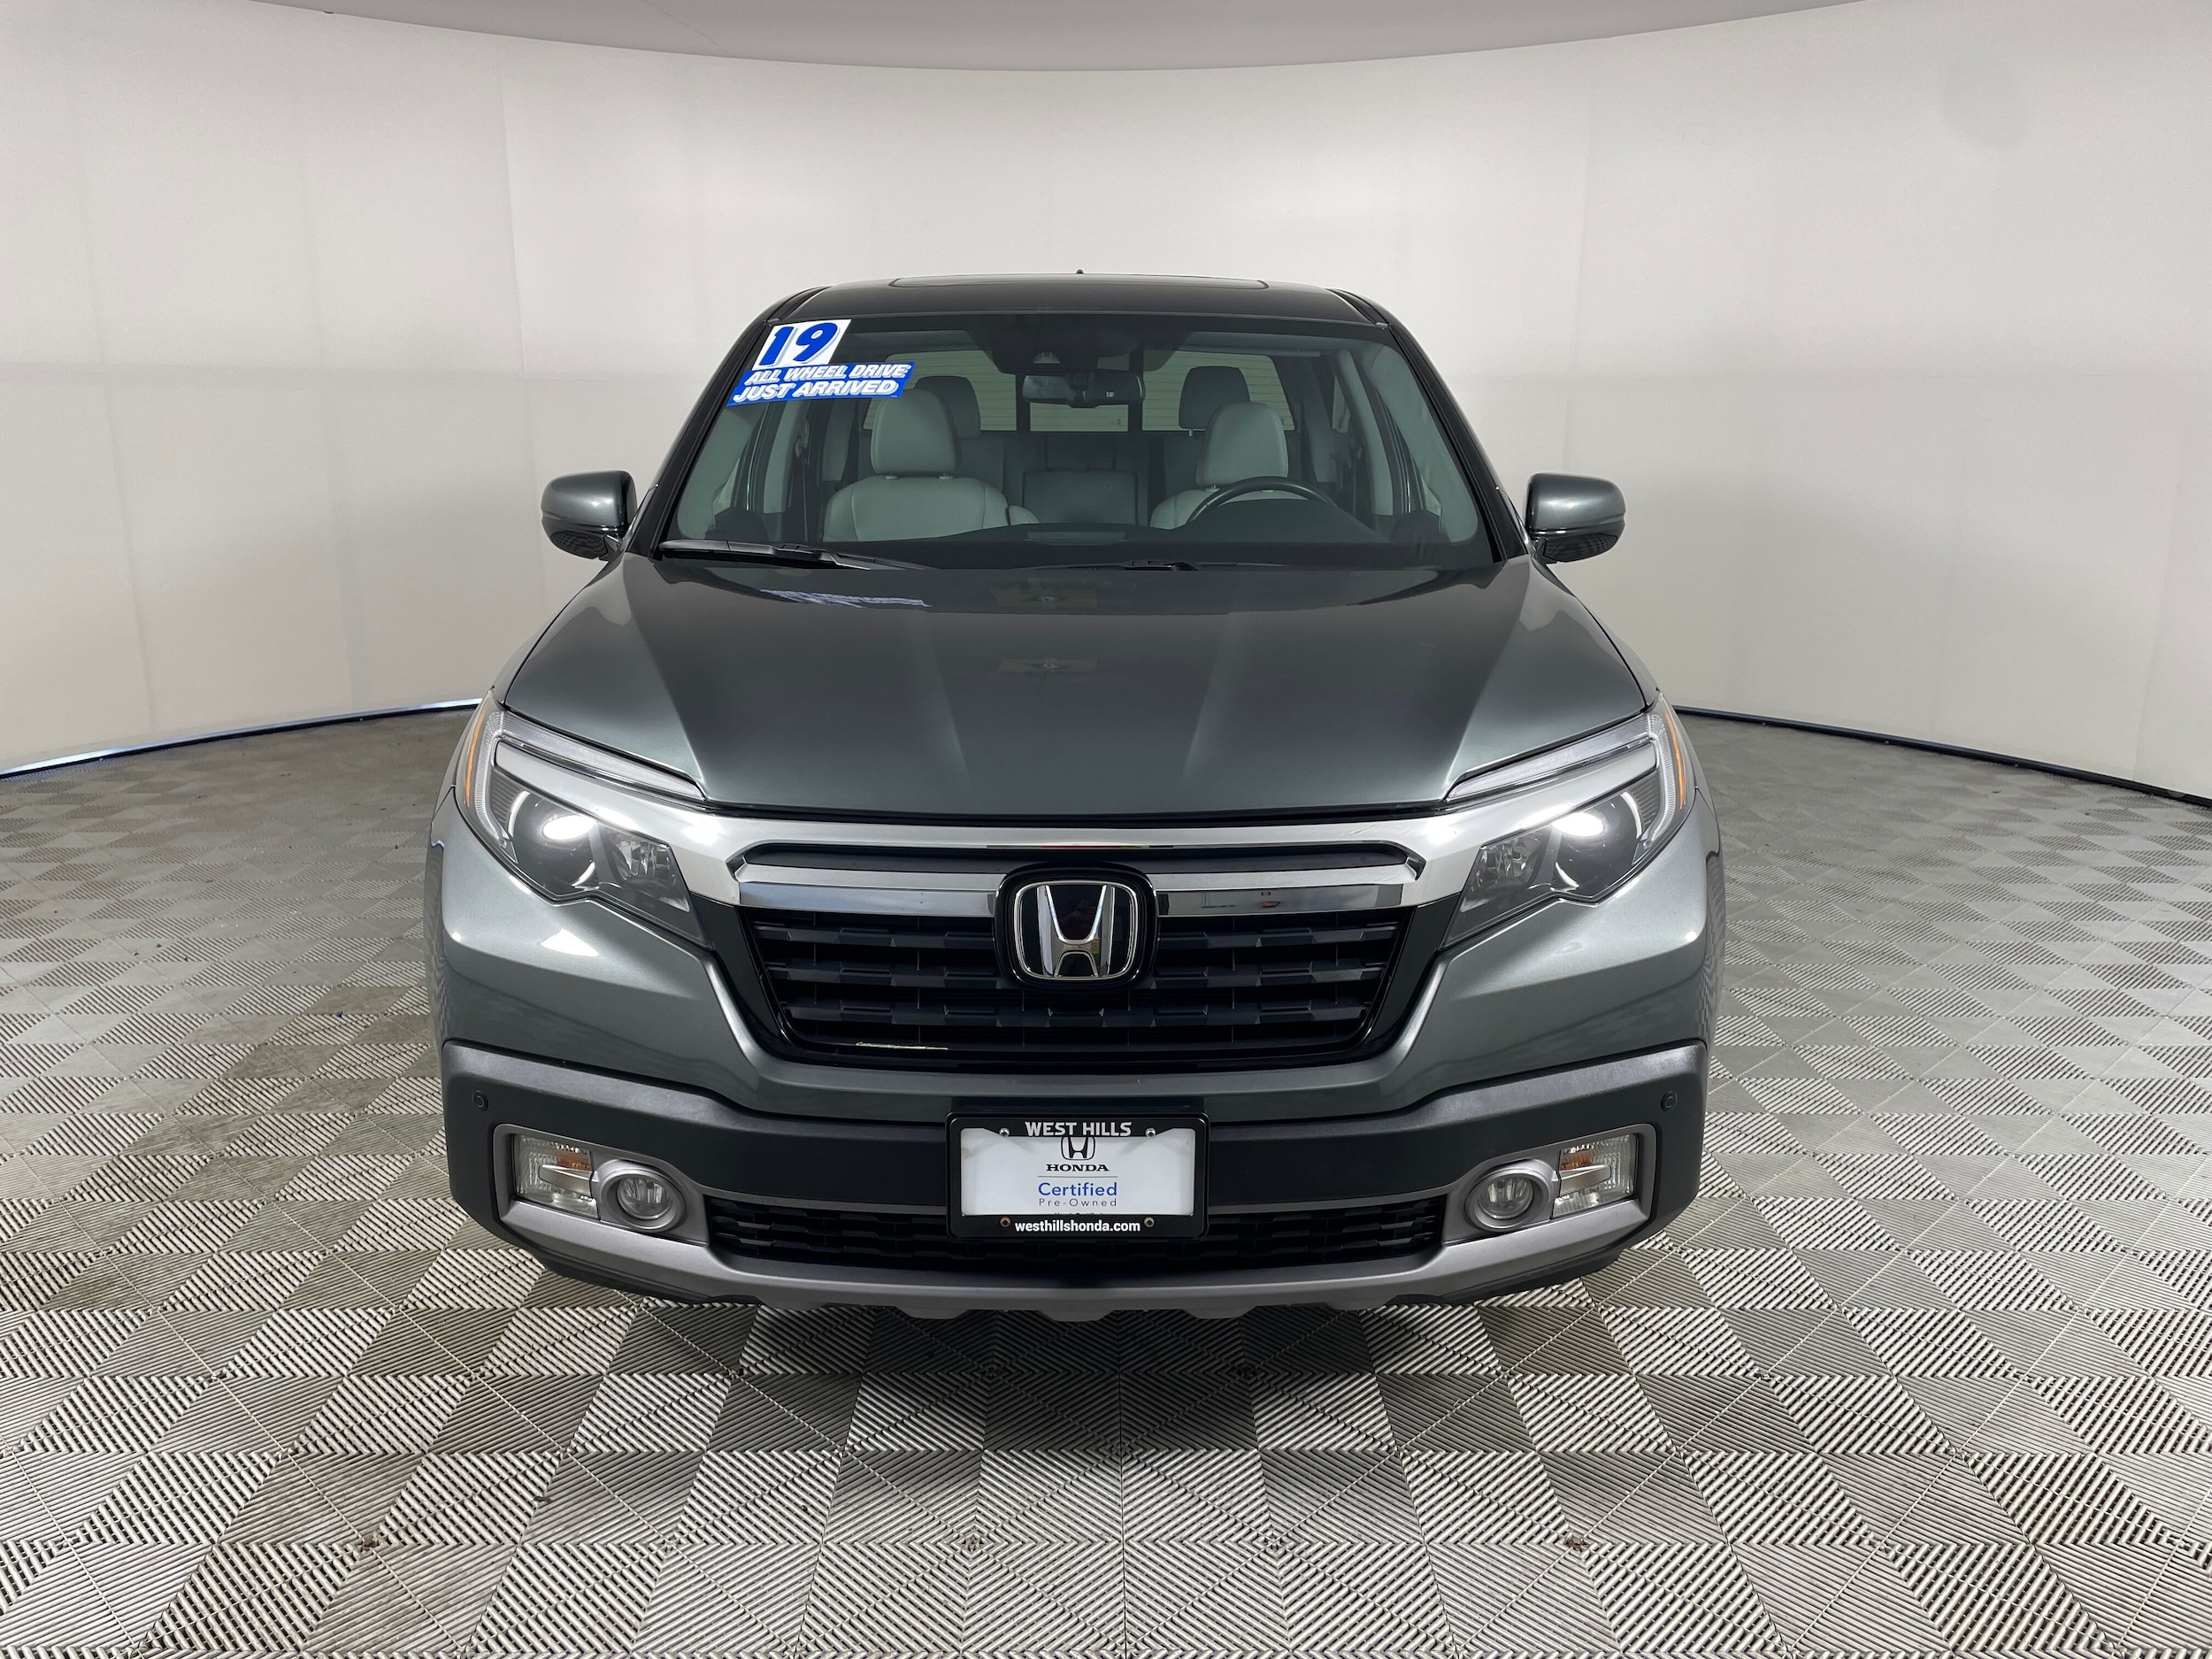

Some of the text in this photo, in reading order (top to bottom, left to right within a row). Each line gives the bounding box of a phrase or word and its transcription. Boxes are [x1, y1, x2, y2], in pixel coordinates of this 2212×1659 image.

[757, 322, 838, 366] 19
[744, 364, 911, 386] ALL WHEEL DRIVE
[733, 380, 899, 403] JUST ARRIVED
[1025, 1121, 1133, 1137] WEST HILLS
[1038, 1182, 1118, 1196] Certified
[1039, 1198, 1117, 1207] Pre-Owned
[1015, 1219, 1141, 1232] westhillshonda.com
